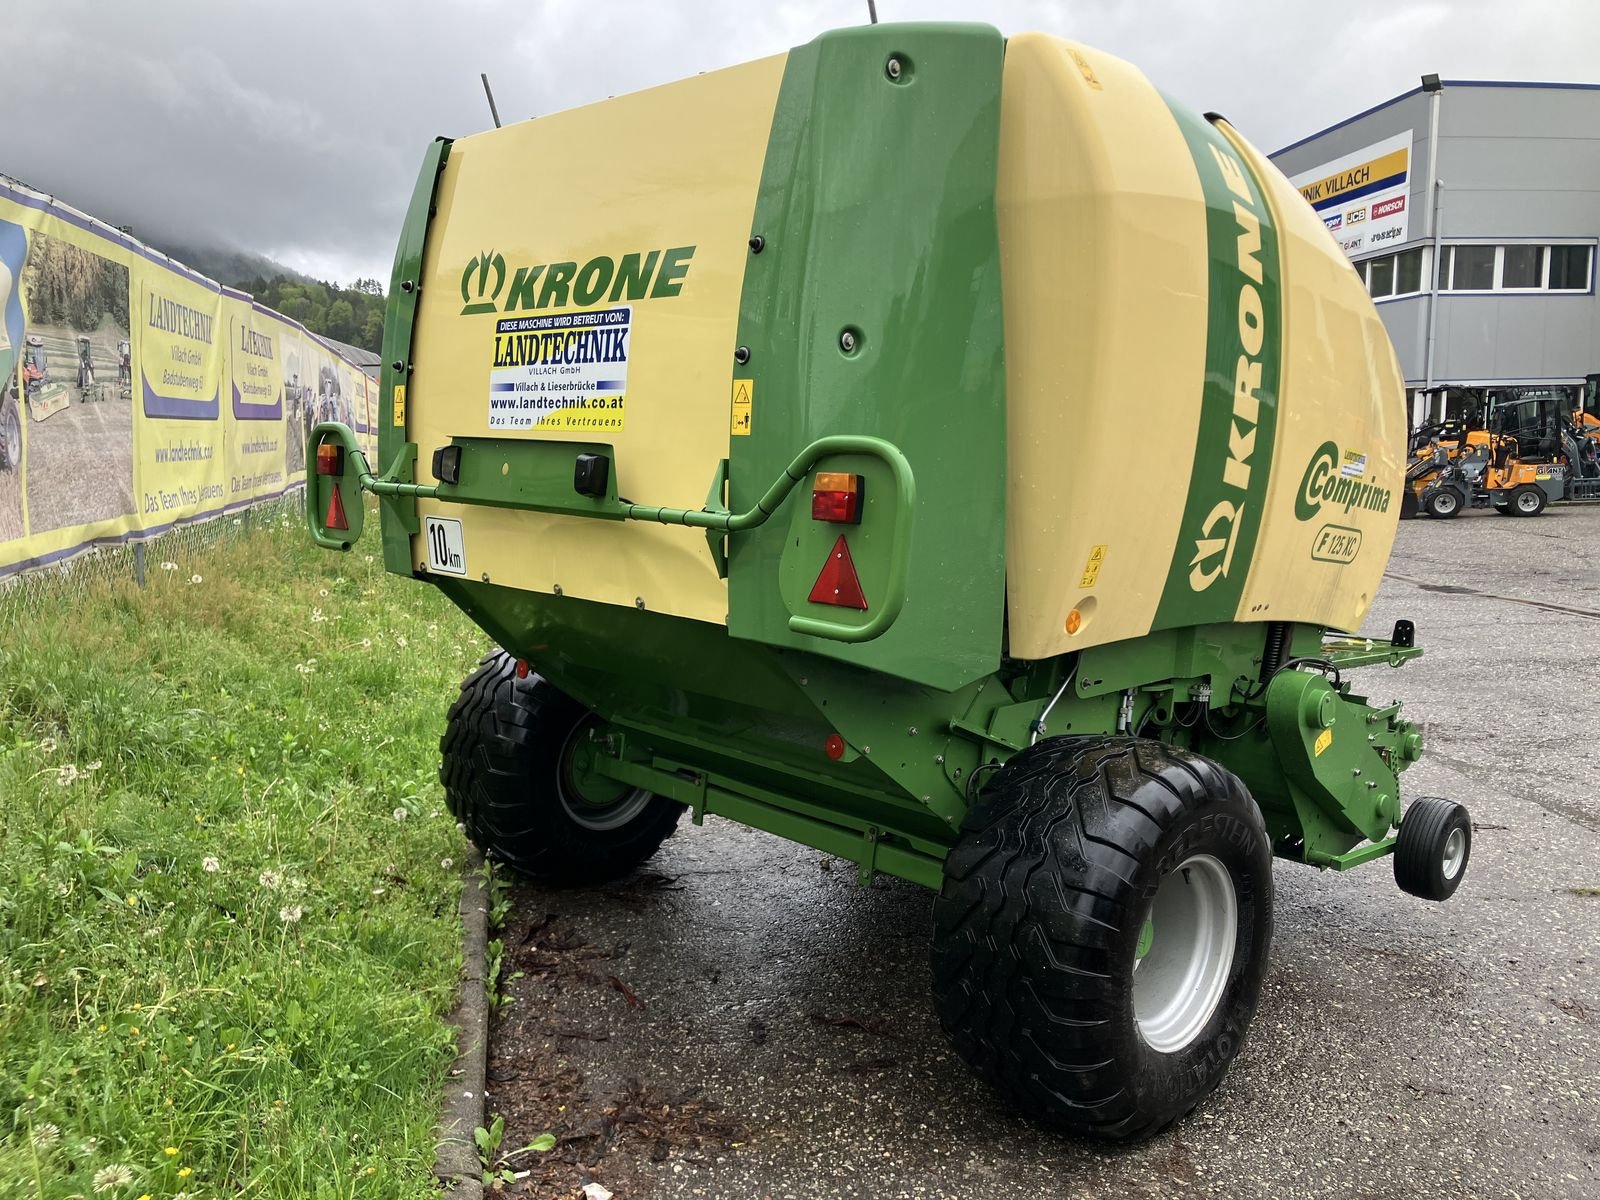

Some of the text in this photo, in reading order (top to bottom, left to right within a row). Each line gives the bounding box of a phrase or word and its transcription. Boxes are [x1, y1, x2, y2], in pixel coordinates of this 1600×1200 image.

[1325, 166, 1370, 195] VILLACH
[1377, 199, 1404, 215] HORSCH
[1347, 209, 1365, 225] JCB
[1371, 227, 1402, 242] JOSKIN
[504, 246, 697, 312] KRONE
[500, 312, 625, 331] DIESE MASCHINE WIRD BETREUT VON:
[1208, 143, 1264, 490] KRONE
[171, 345, 187, 363] Villach
[493, 328, 628, 367] LANDTECHNIK
[528, 366, 581, 375] VILLACH GmbH
[515, 381, 595, 392] Villach & Lieserbrücke
[491, 396, 623, 409] www.landtechnik.co.at
[490, 416, 622, 427] Das Team Ihres Vertrauens
[1295, 441, 1391, 521] Comprima
[144, 492, 159, 514] Das
[159, 490, 180, 510] Team
[179, 485, 197, 505] Ihres
[430, 523, 448, 566] 10
[1317, 532, 1357, 557] F 125 XC
